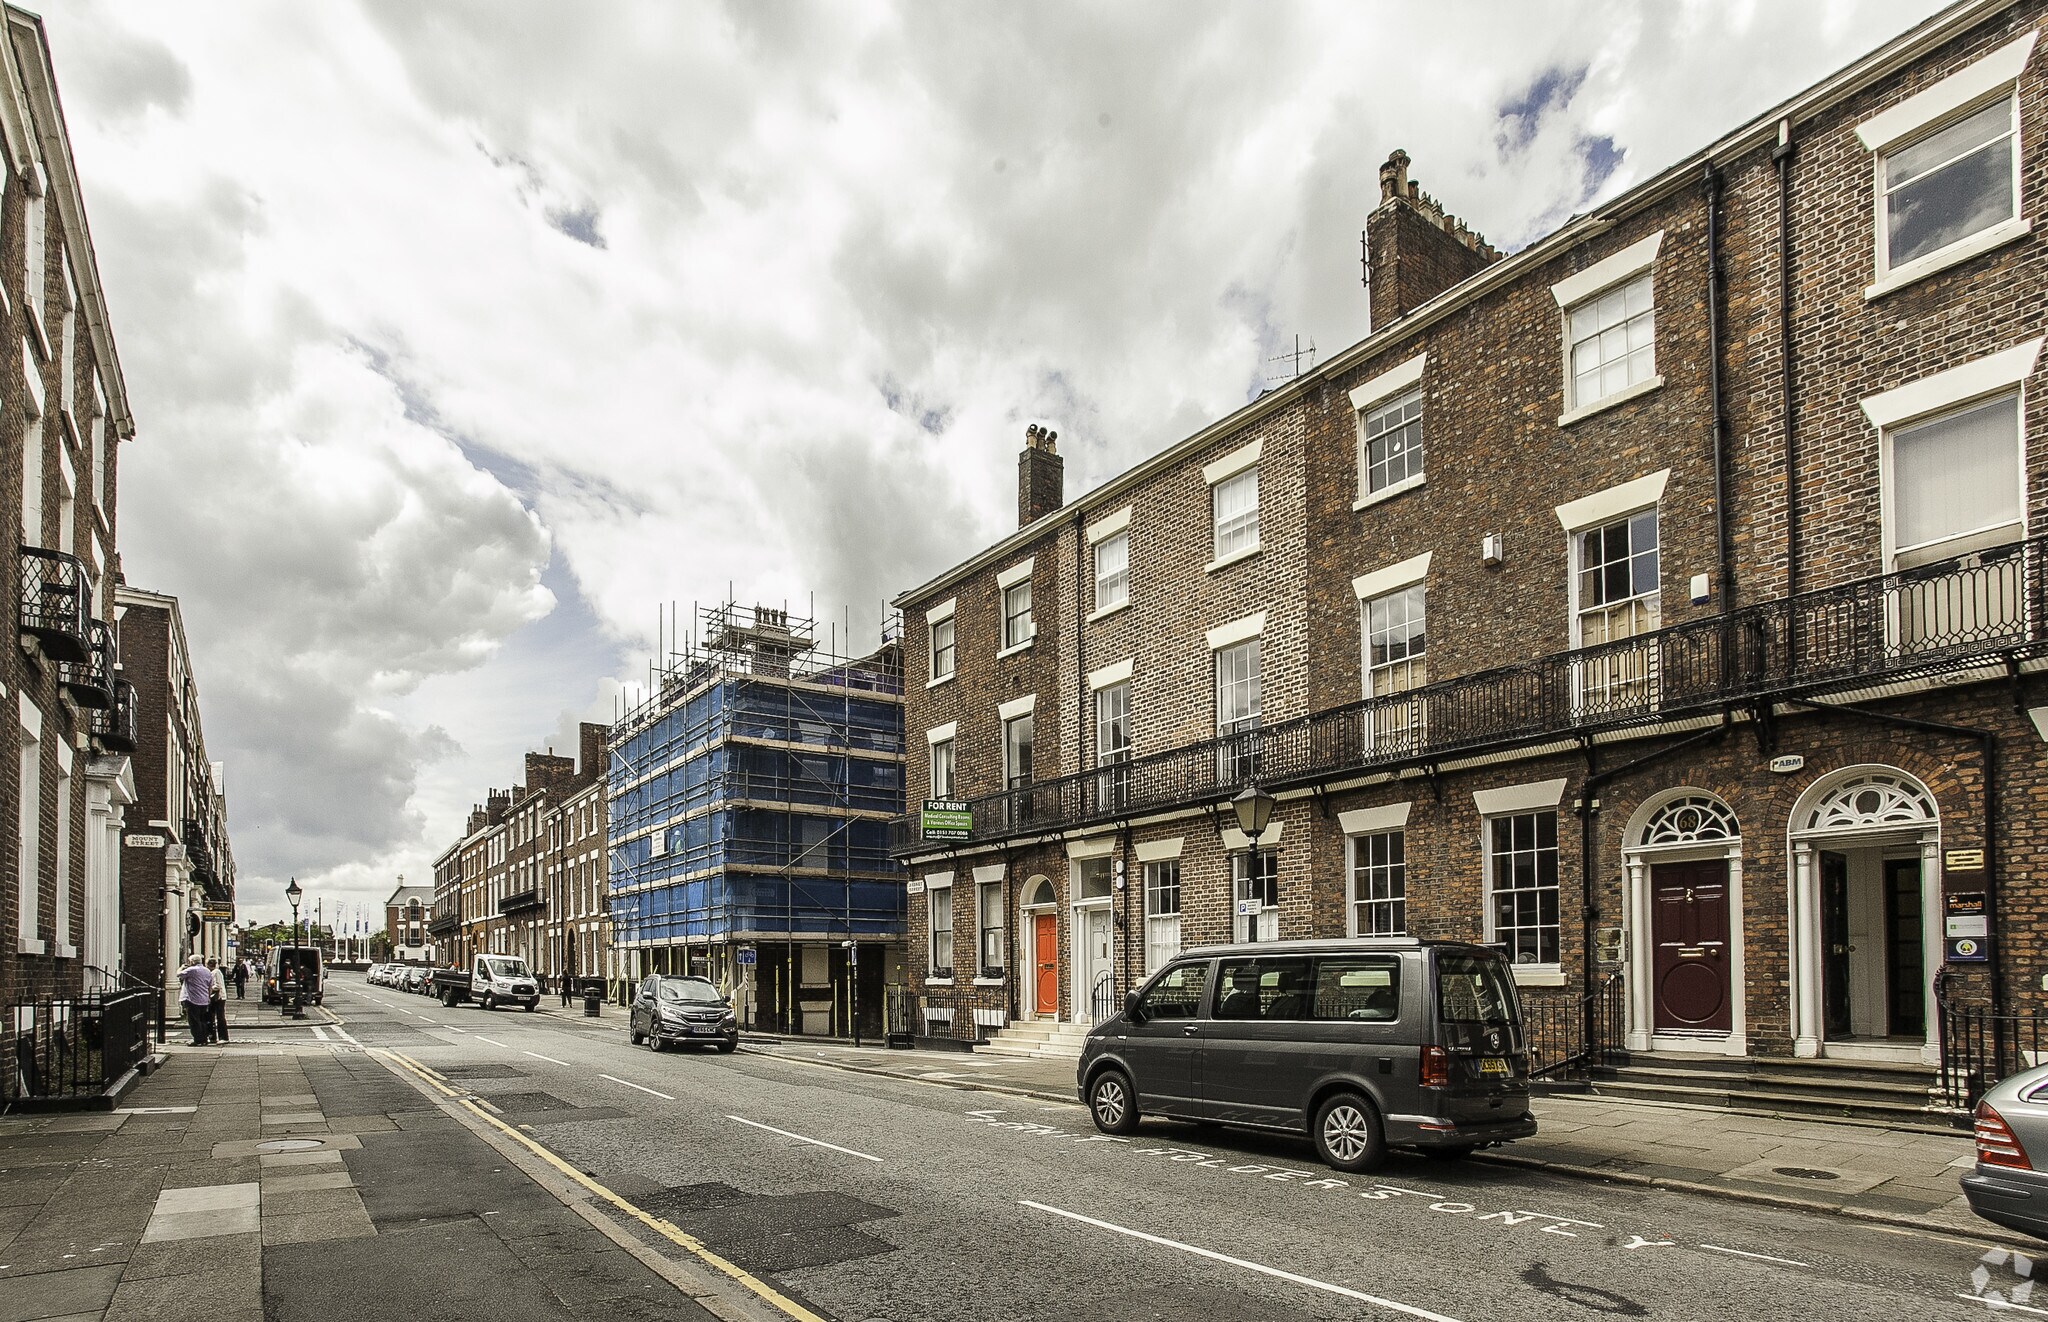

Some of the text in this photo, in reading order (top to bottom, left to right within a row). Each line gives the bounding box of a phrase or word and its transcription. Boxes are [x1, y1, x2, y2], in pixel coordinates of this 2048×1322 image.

[1779, 758, 1801, 767] ABM
[928, 802, 944, 810] FOR
[1680, 814, 1696, 829] 68
[964, 1117, 1676, 1250] PERMIT HOLDERS ONLY
